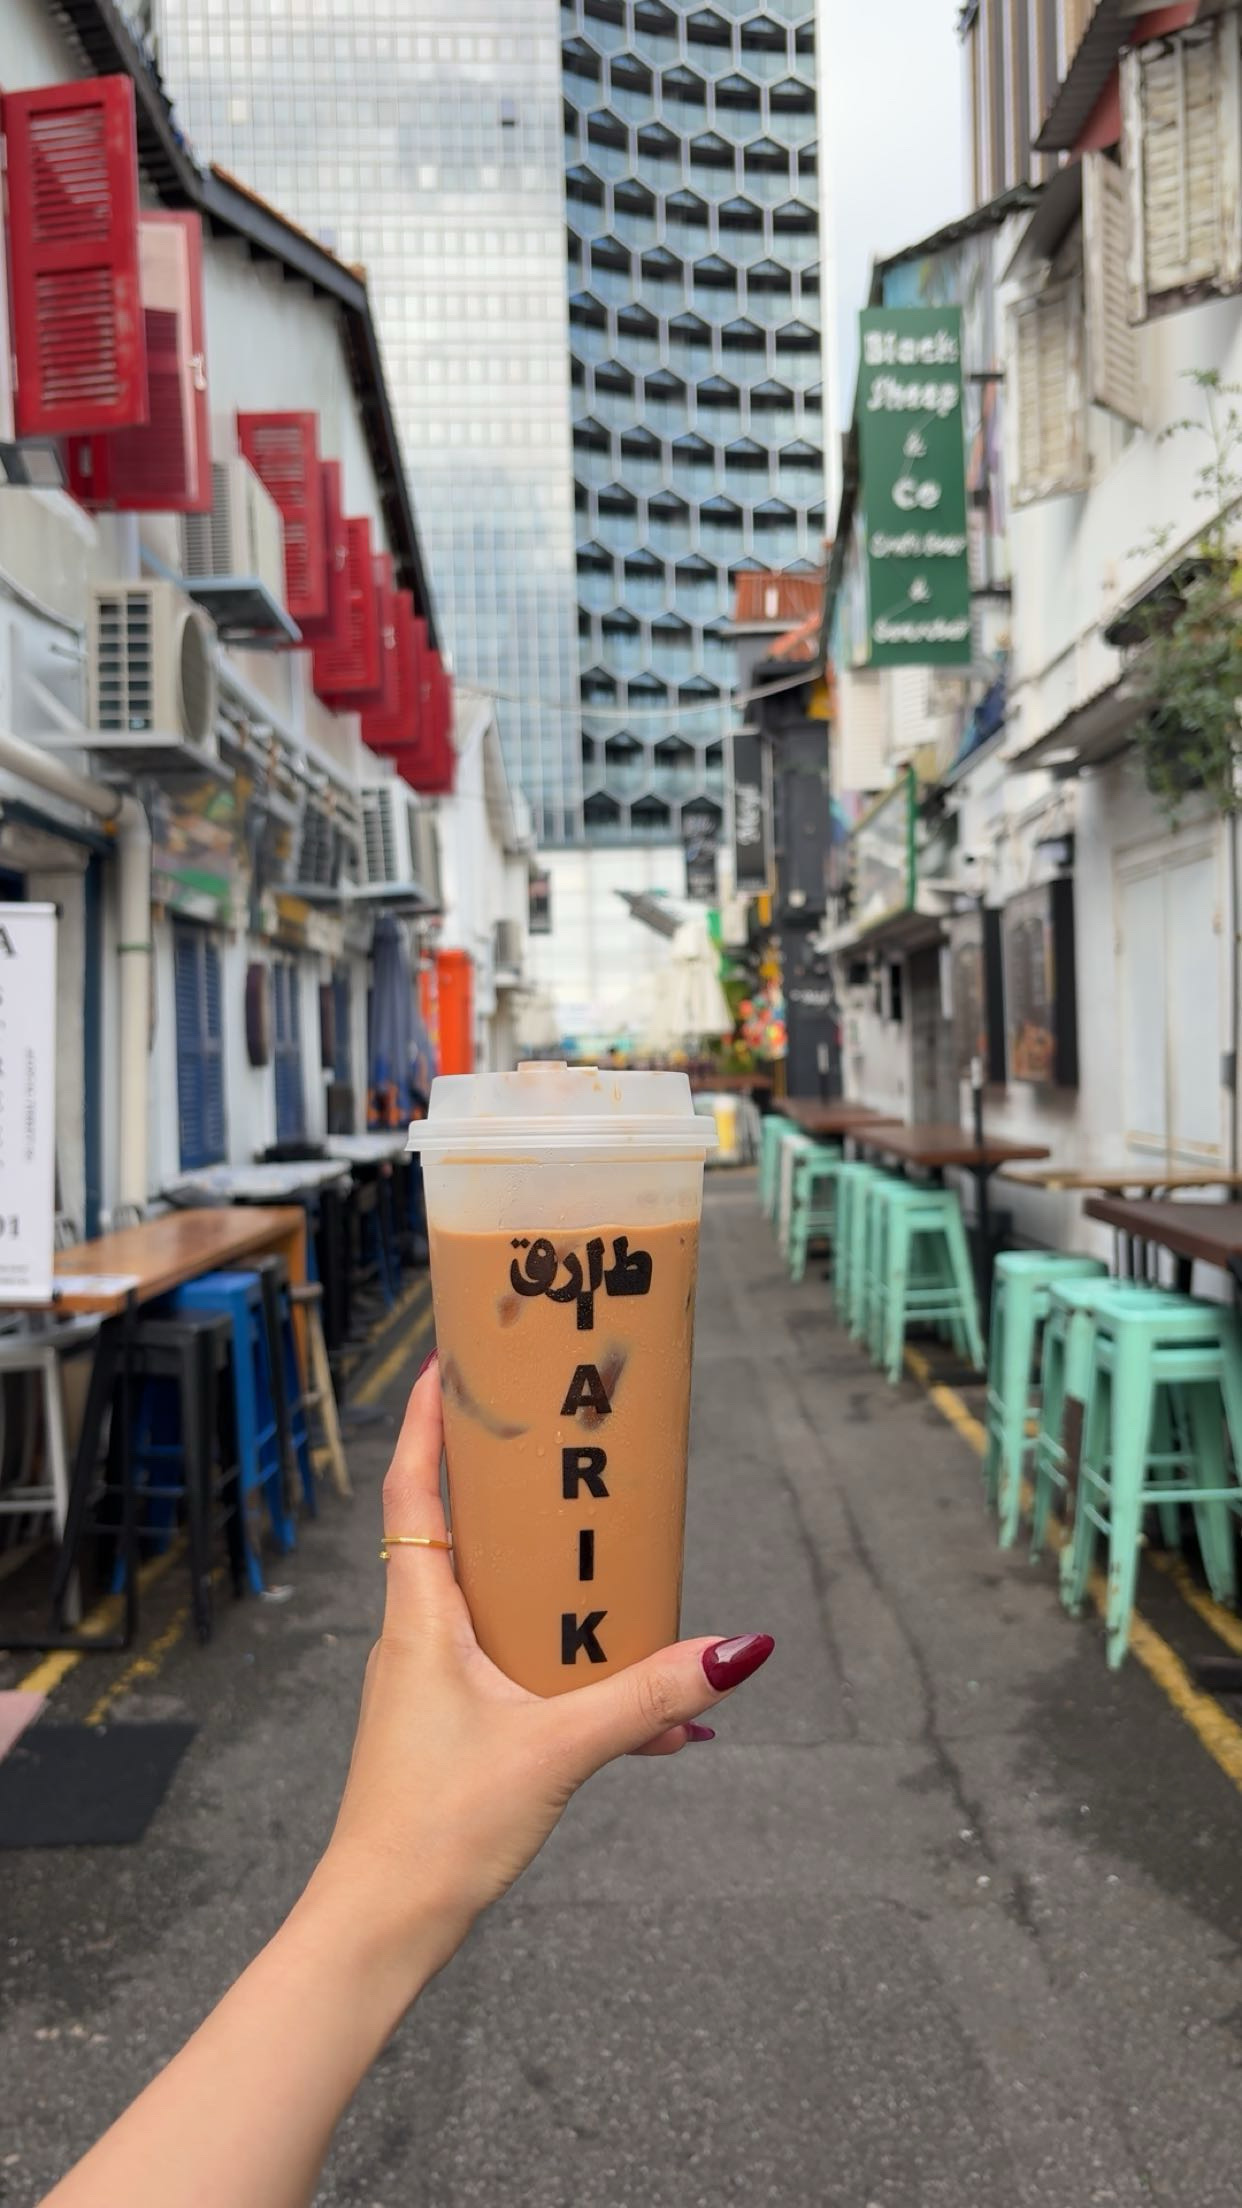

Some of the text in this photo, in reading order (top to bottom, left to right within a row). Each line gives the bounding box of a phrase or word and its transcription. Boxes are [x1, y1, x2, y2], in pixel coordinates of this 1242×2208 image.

[864, 330, 958, 365] Black
[866, 376, 958, 418] Sheep
[892, 477, 941, 511] Co
[510, 1236, 653, 1303] طارق
